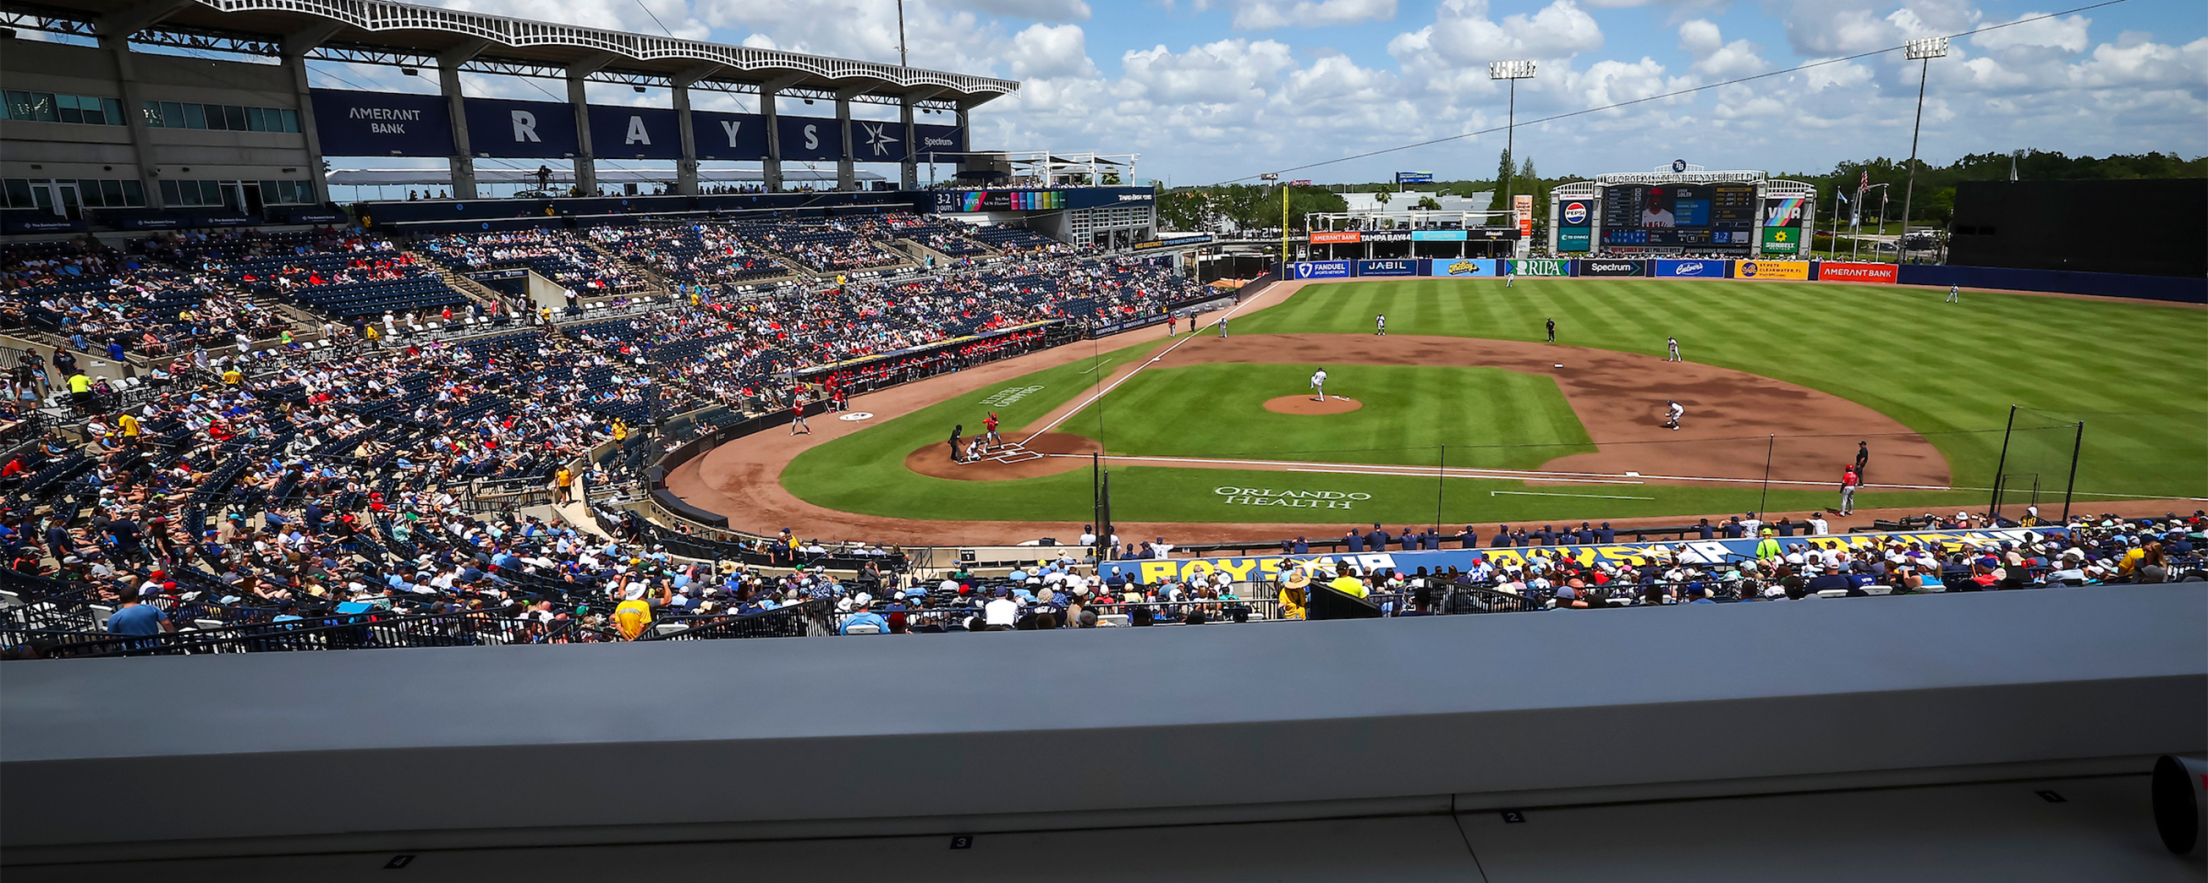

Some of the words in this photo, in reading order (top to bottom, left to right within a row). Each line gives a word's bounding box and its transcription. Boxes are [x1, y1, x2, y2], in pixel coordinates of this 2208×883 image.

[350, 108, 420, 121] AMERANT
[371, 122, 405, 134] BANK
[511, 110, 541, 142] R
[625, 116, 650, 145] A
[720, 121, 741, 148] Y
[804, 124, 818, 150] S
[924, 136, 952, 147] Spectrum
[937, 194, 951, 204] 3-2
[1768, 207, 1800, 219] VIVA
[1369, 262, 1406, 270] JABIL
[1530, 260, 1561, 275] RIPA
[1592, 263, 1631, 272] Spectrum
[1676, 262, 1704, 274] Culver's
[1825, 268, 1868, 277] AMERANT
[1869, 270, 1892, 278] BANK
[1215, 486, 1372, 500] ORLANDO
[1225, 496, 1352, 509] HEALTH
[1140, 558, 1283, 584] RAYS
[956, 838, 966, 847] 3
